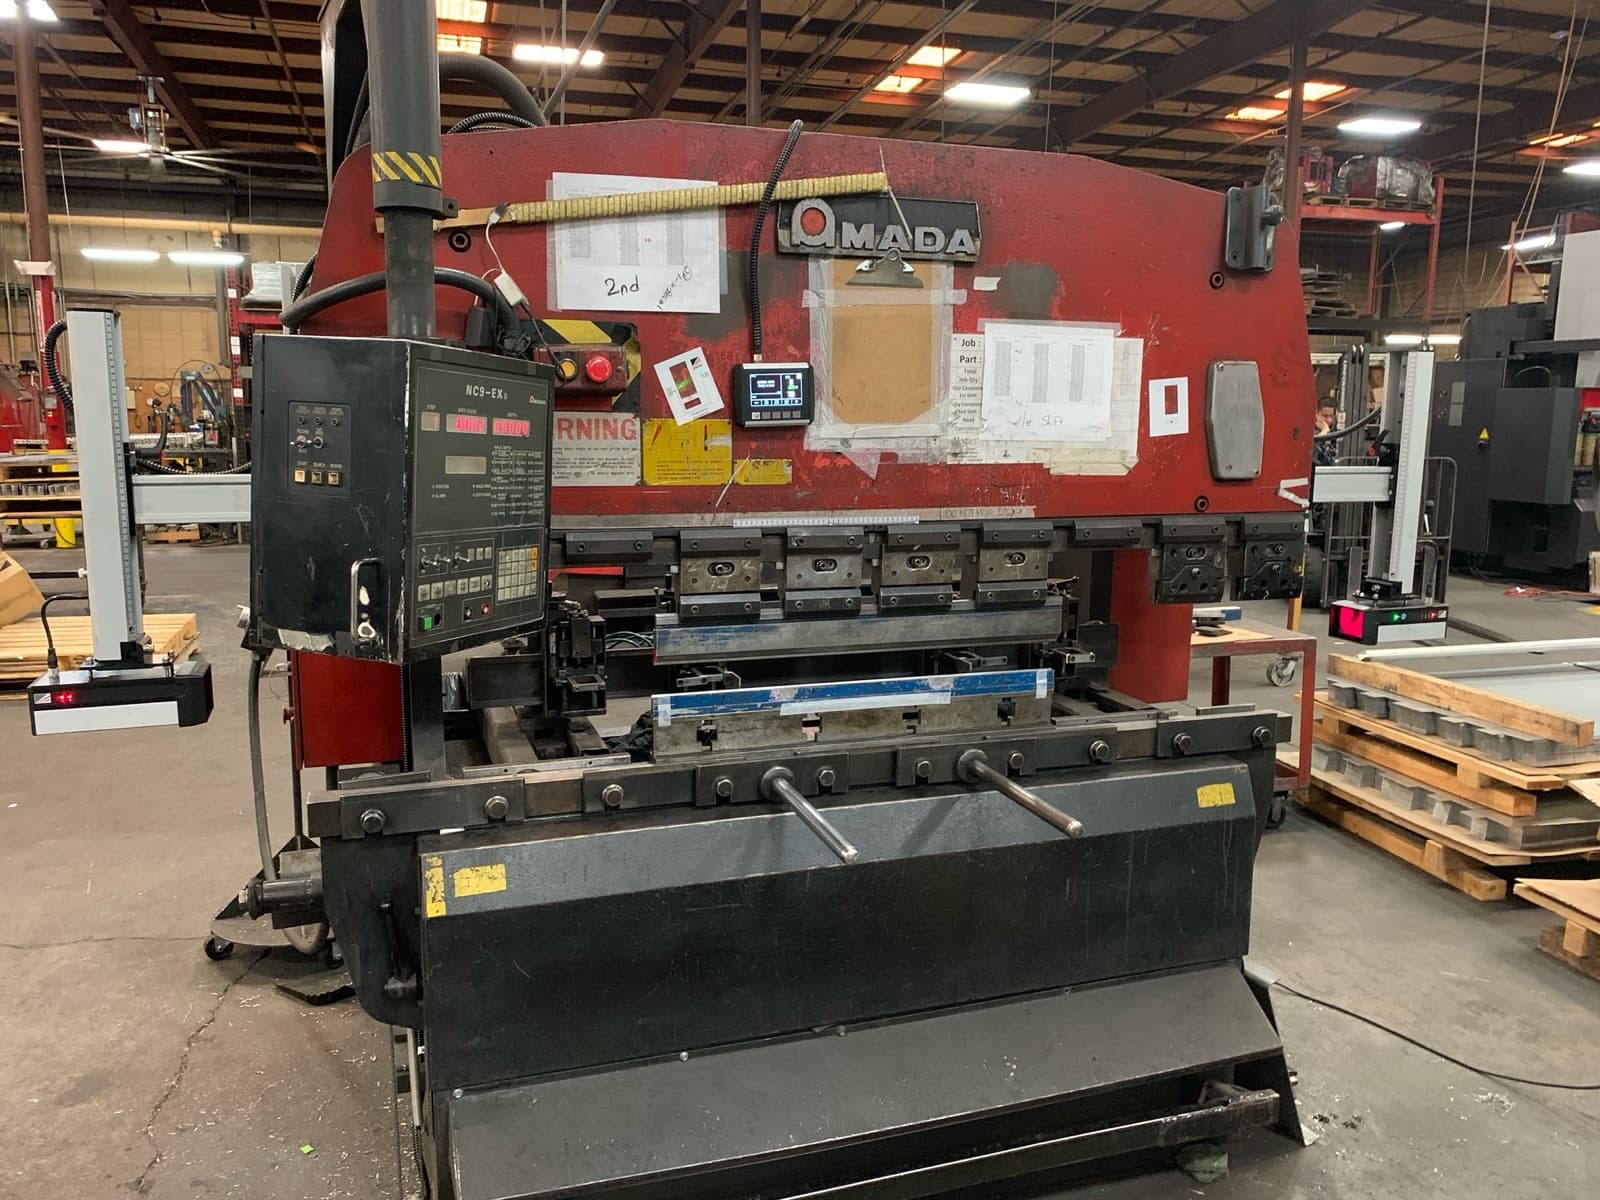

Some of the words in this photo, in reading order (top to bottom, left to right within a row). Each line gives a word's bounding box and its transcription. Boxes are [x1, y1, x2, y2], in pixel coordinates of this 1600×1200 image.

[604, 274, 640, 297] 2nd
[961, 338, 976, 348] Job
[959, 355, 977, 364] Part
[554, 418, 637, 440] RNING
